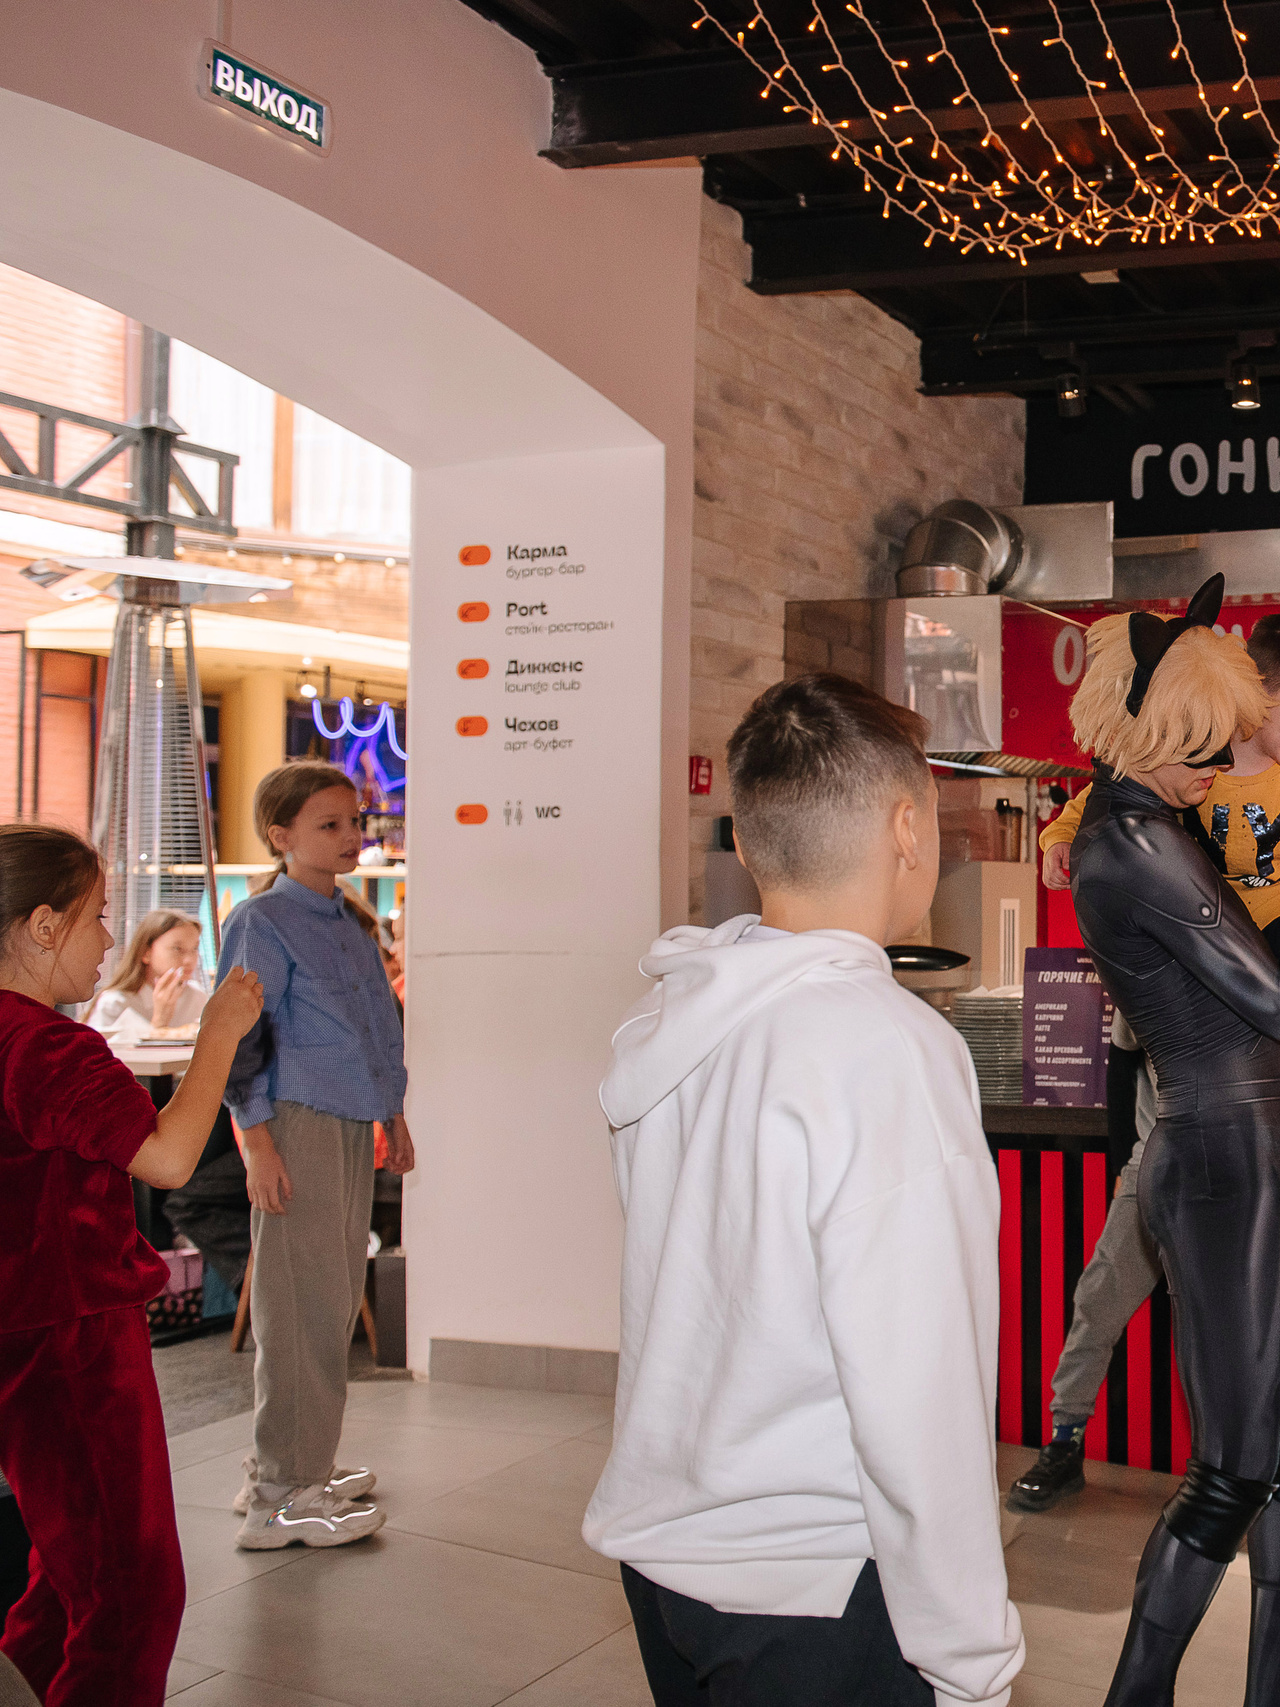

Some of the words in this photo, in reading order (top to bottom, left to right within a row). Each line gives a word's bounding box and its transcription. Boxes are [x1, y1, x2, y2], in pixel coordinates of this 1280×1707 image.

[215, 58, 320, 141] ВЫХОД
[507, 545, 567, 562] Карма
[506, 602, 548, 617] Port
[505, 660, 583, 676] Диккенс
[505, 681, 548, 694] lounge
[552, 679, 581, 692] club
[505, 717, 559, 732] Чехов
[535, 805, 561, 818] WC
[1038, 971, 1084, 984] ГОРЯЧИЕ
[1035, 1003, 1068, 1011] АМЕРИКАНО
